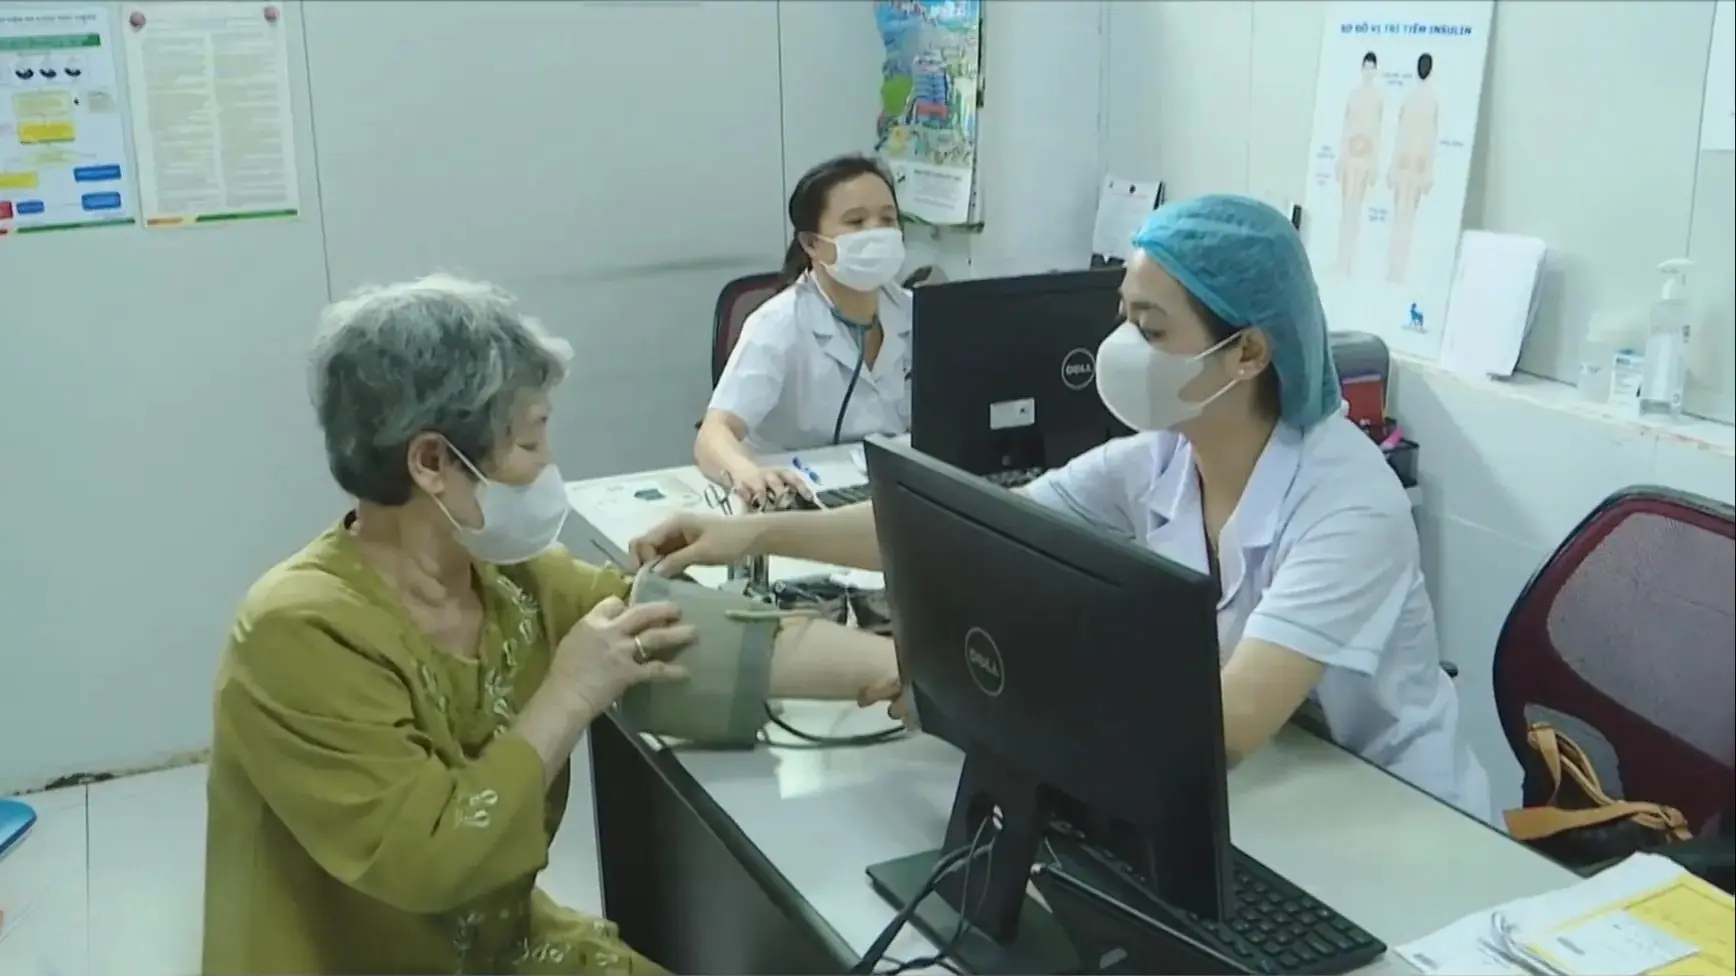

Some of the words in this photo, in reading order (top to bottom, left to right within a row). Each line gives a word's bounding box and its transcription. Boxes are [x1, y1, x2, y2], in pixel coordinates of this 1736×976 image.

[1429, 24, 1472, 36] INSULIN
[1066, 363, 1091, 376] DELL
[969, 647, 1000, 678] DELL
